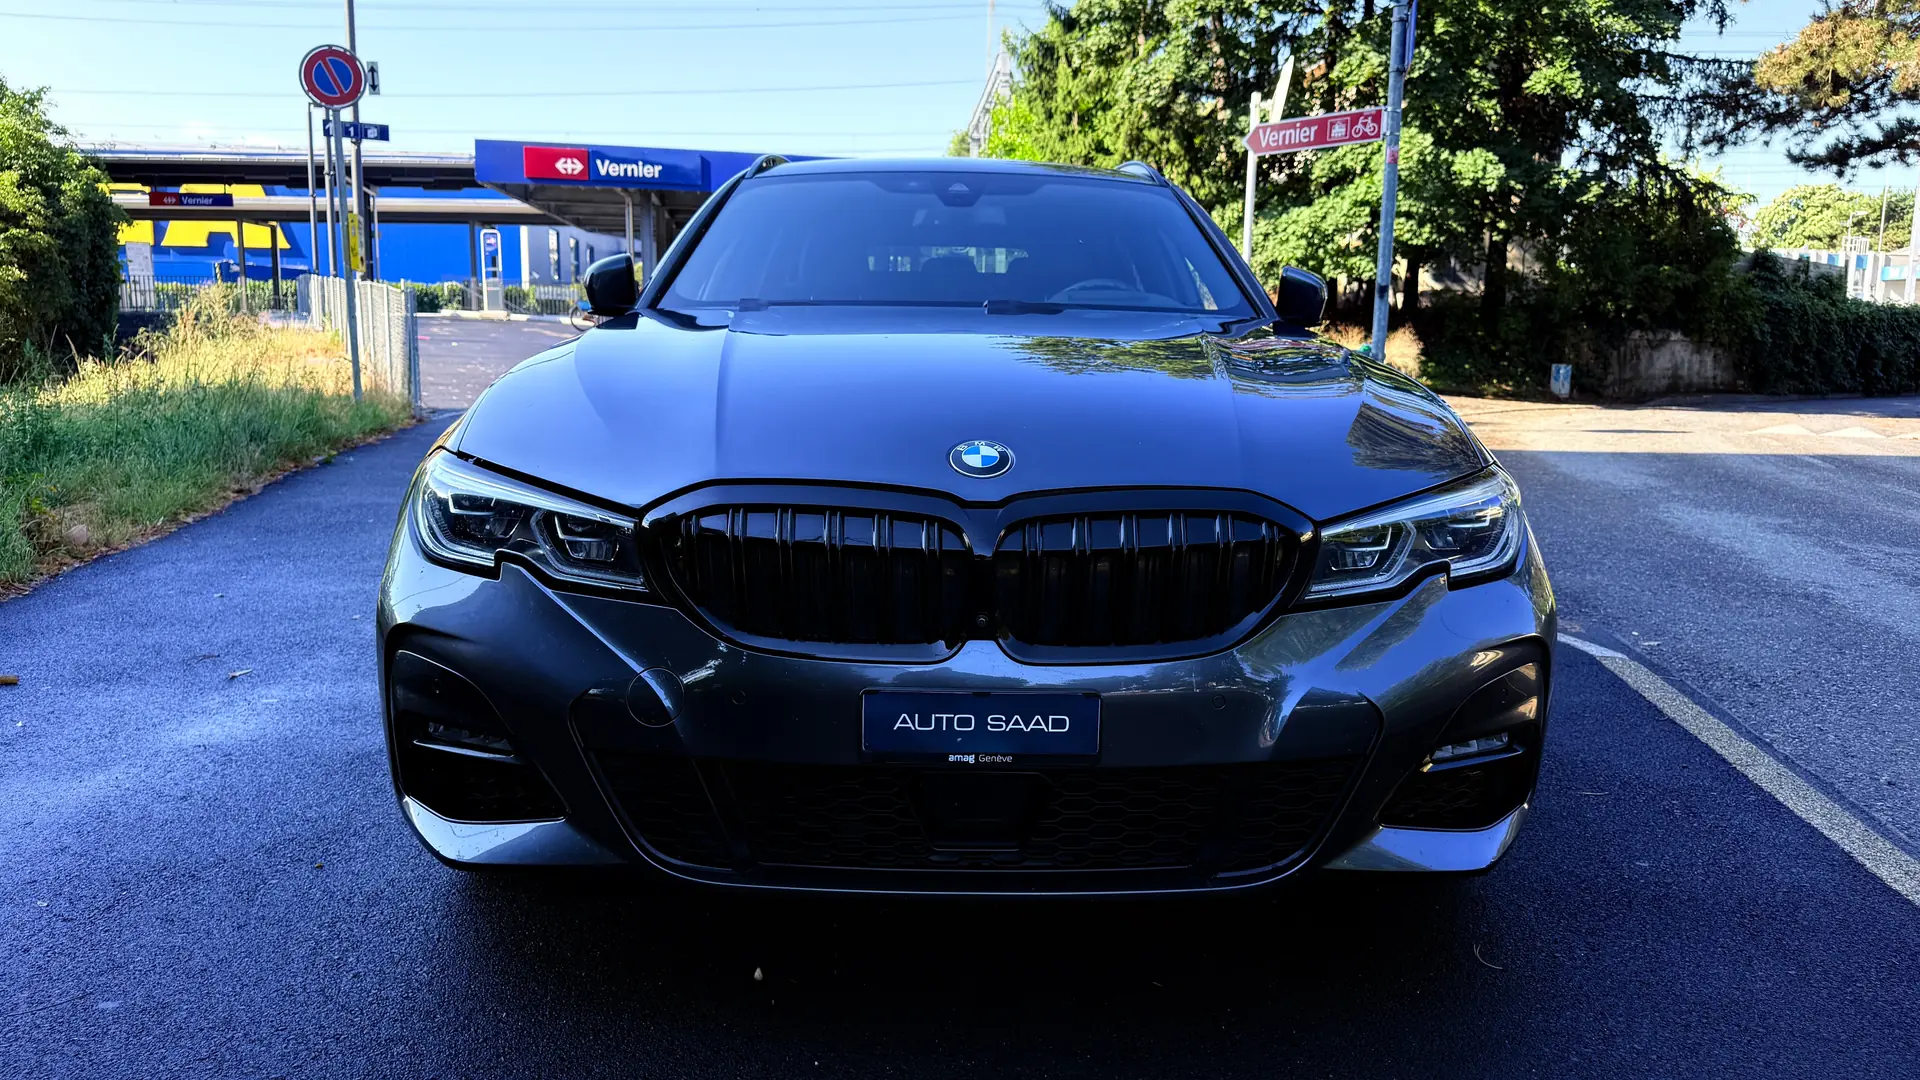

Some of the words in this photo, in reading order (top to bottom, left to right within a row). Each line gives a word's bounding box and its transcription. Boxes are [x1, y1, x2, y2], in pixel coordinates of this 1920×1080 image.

[1259, 122, 1318, 148] Vernier
[595, 158, 663, 178] Vernier
[181, 195, 213, 205] Vernier
[893, 713, 975, 731] AUTO
[987, 714, 1070, 733] SAAD
[948, 753, 975, 764] amag
[978, 753, 1013, 763] Genève
